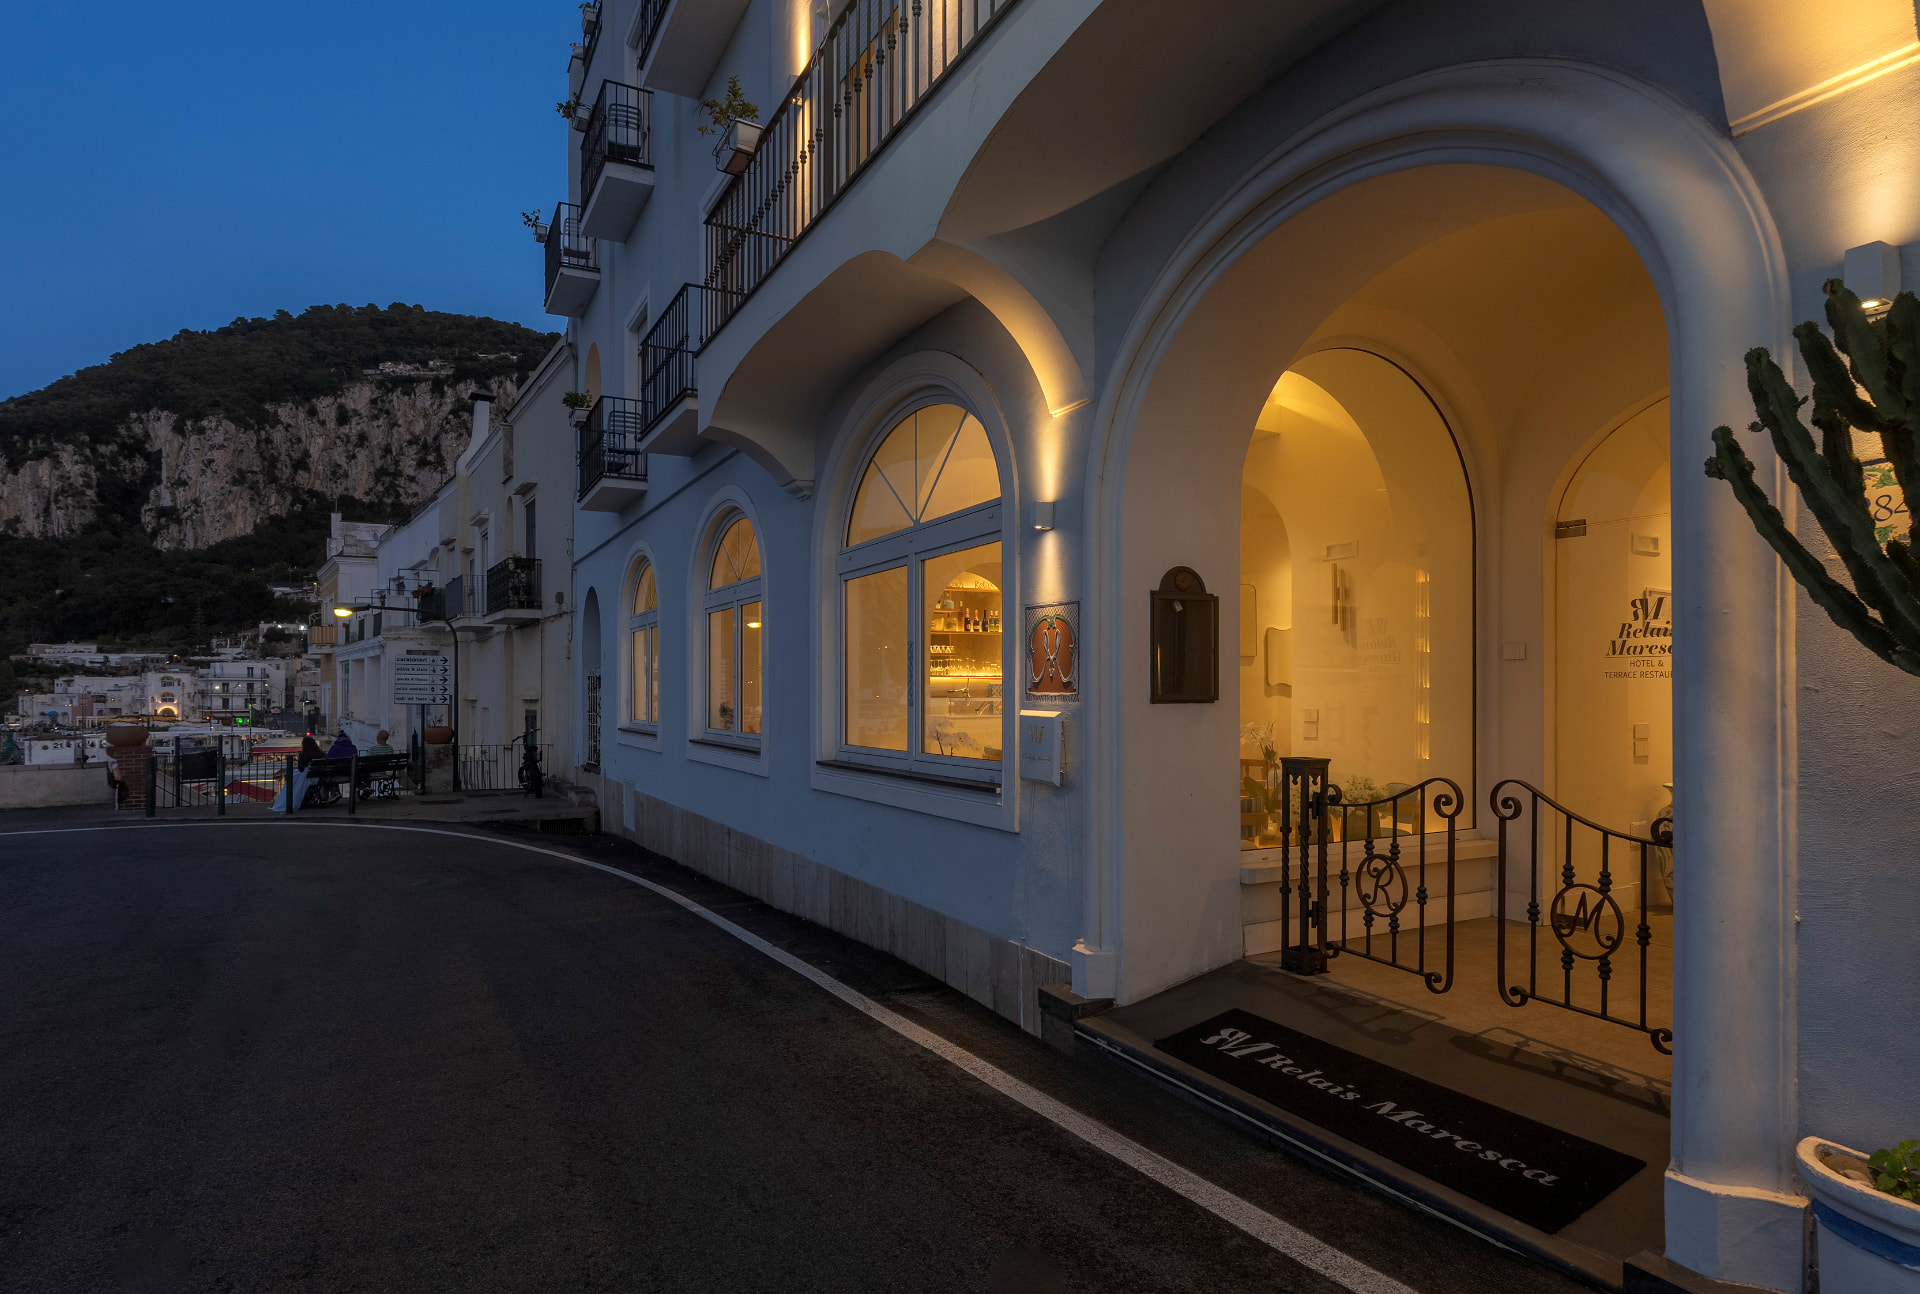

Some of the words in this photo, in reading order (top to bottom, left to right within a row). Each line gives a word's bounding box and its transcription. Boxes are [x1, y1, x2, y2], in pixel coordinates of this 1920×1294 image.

[1864, 494, 1912, 522] 84
[1605, 640, 1673, 656] Maresc
[1629, 660, 1655, 668] HOTEL
[1657, 660, 1665, 668] &
[1604, 671, 1637, 679] TERRACE
[1640, 670, 1673, 679] RESTAU
[1255, 1053, 1361, 1101] Relais
[1361, 1100, 1560, 1186] Maresca
